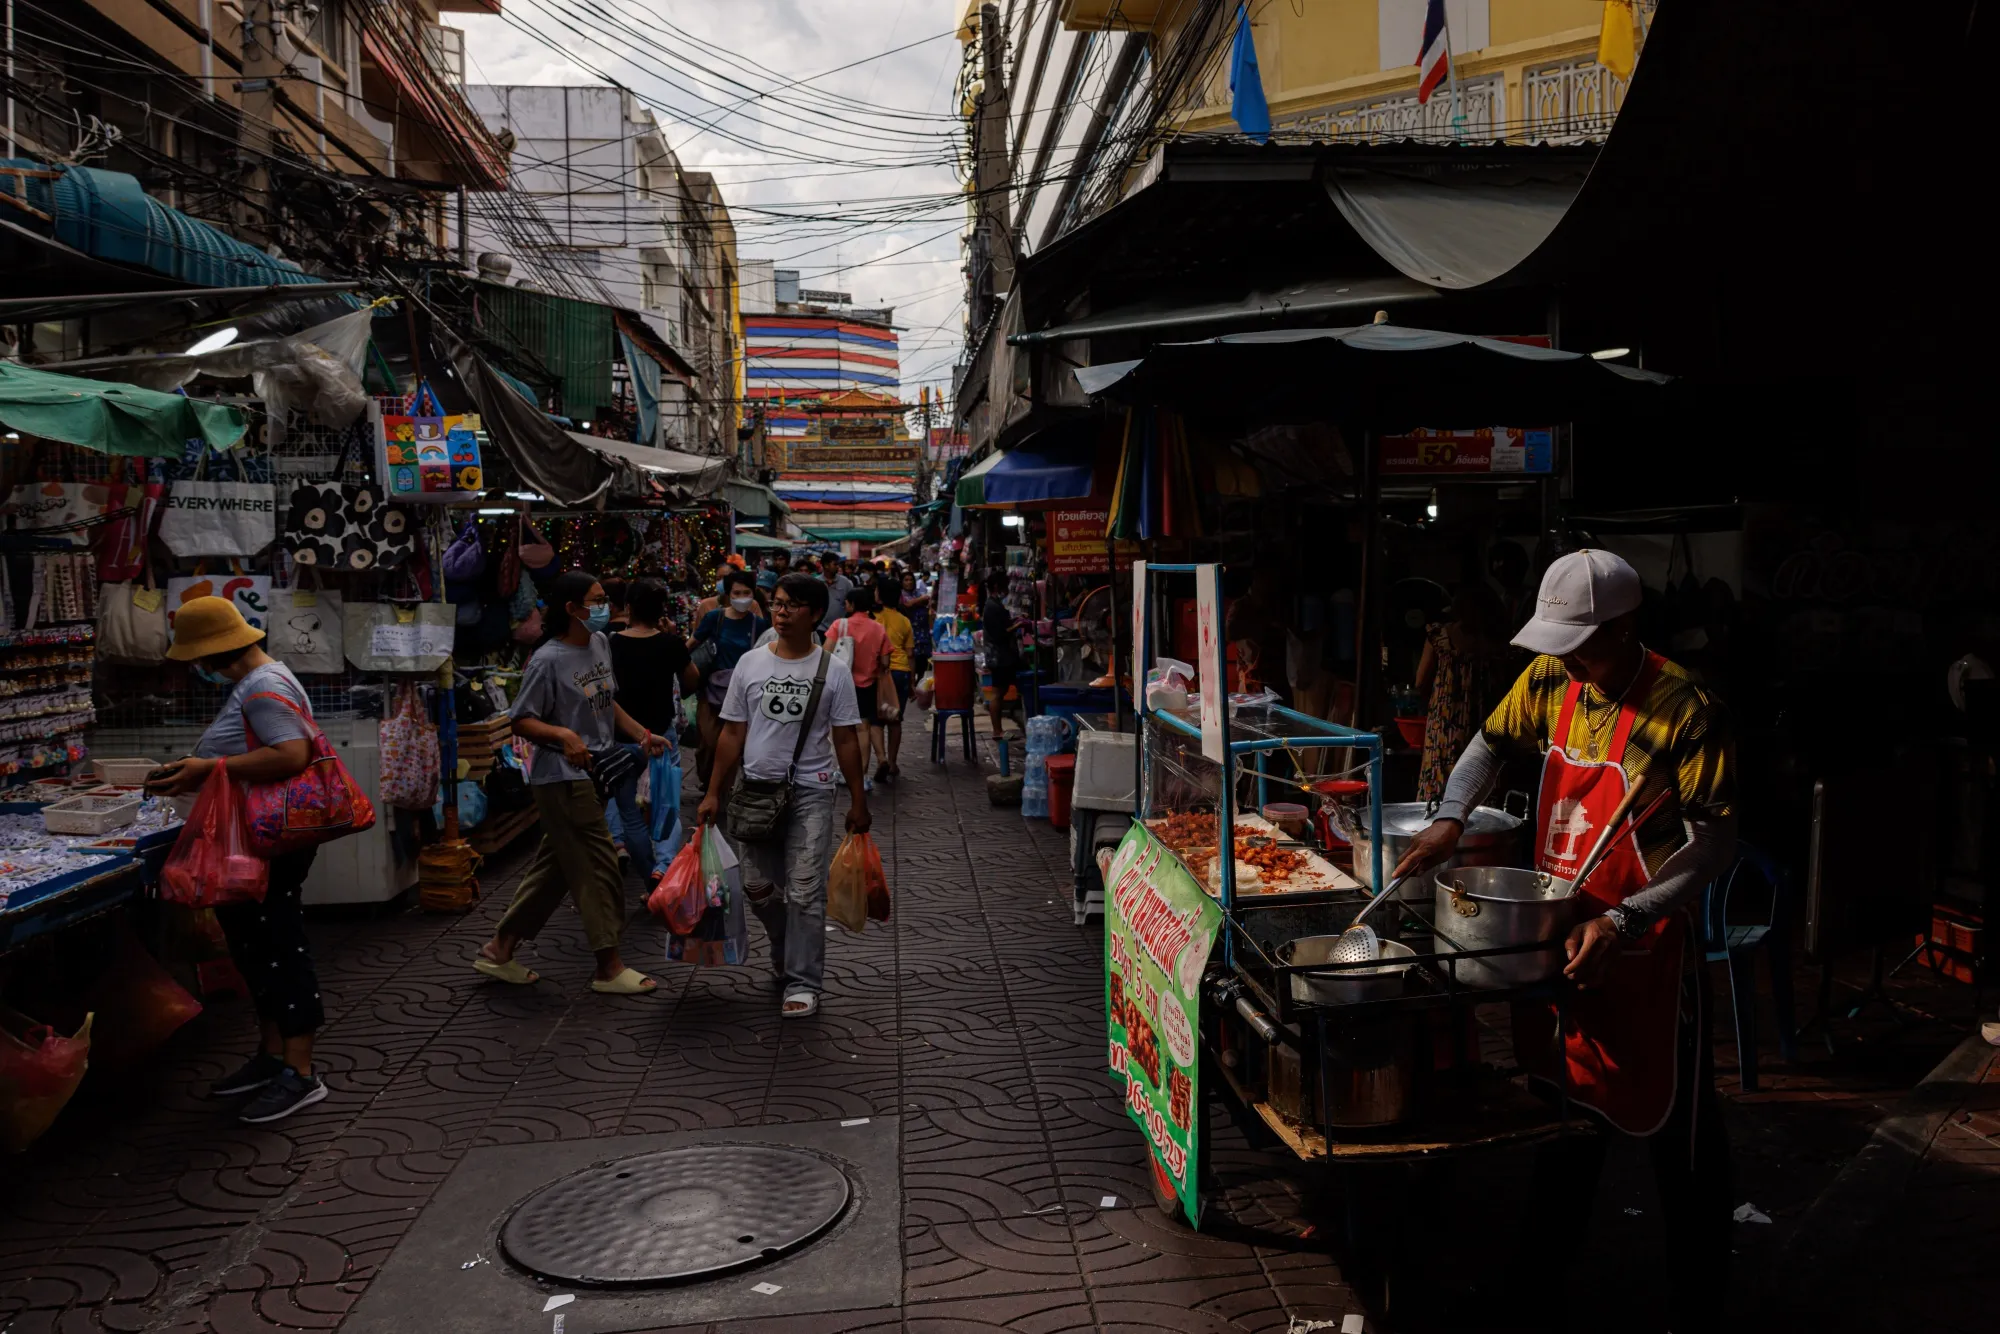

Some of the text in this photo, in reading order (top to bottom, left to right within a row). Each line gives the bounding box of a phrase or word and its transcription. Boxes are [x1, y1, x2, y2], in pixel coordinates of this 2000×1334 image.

[1423, 444, 1457, 466] 50
[168, 496, 273, 512] EVERYWHERE
[767, 683, 809, 696] ROUTE
[768, 695, 803, 716] 66
